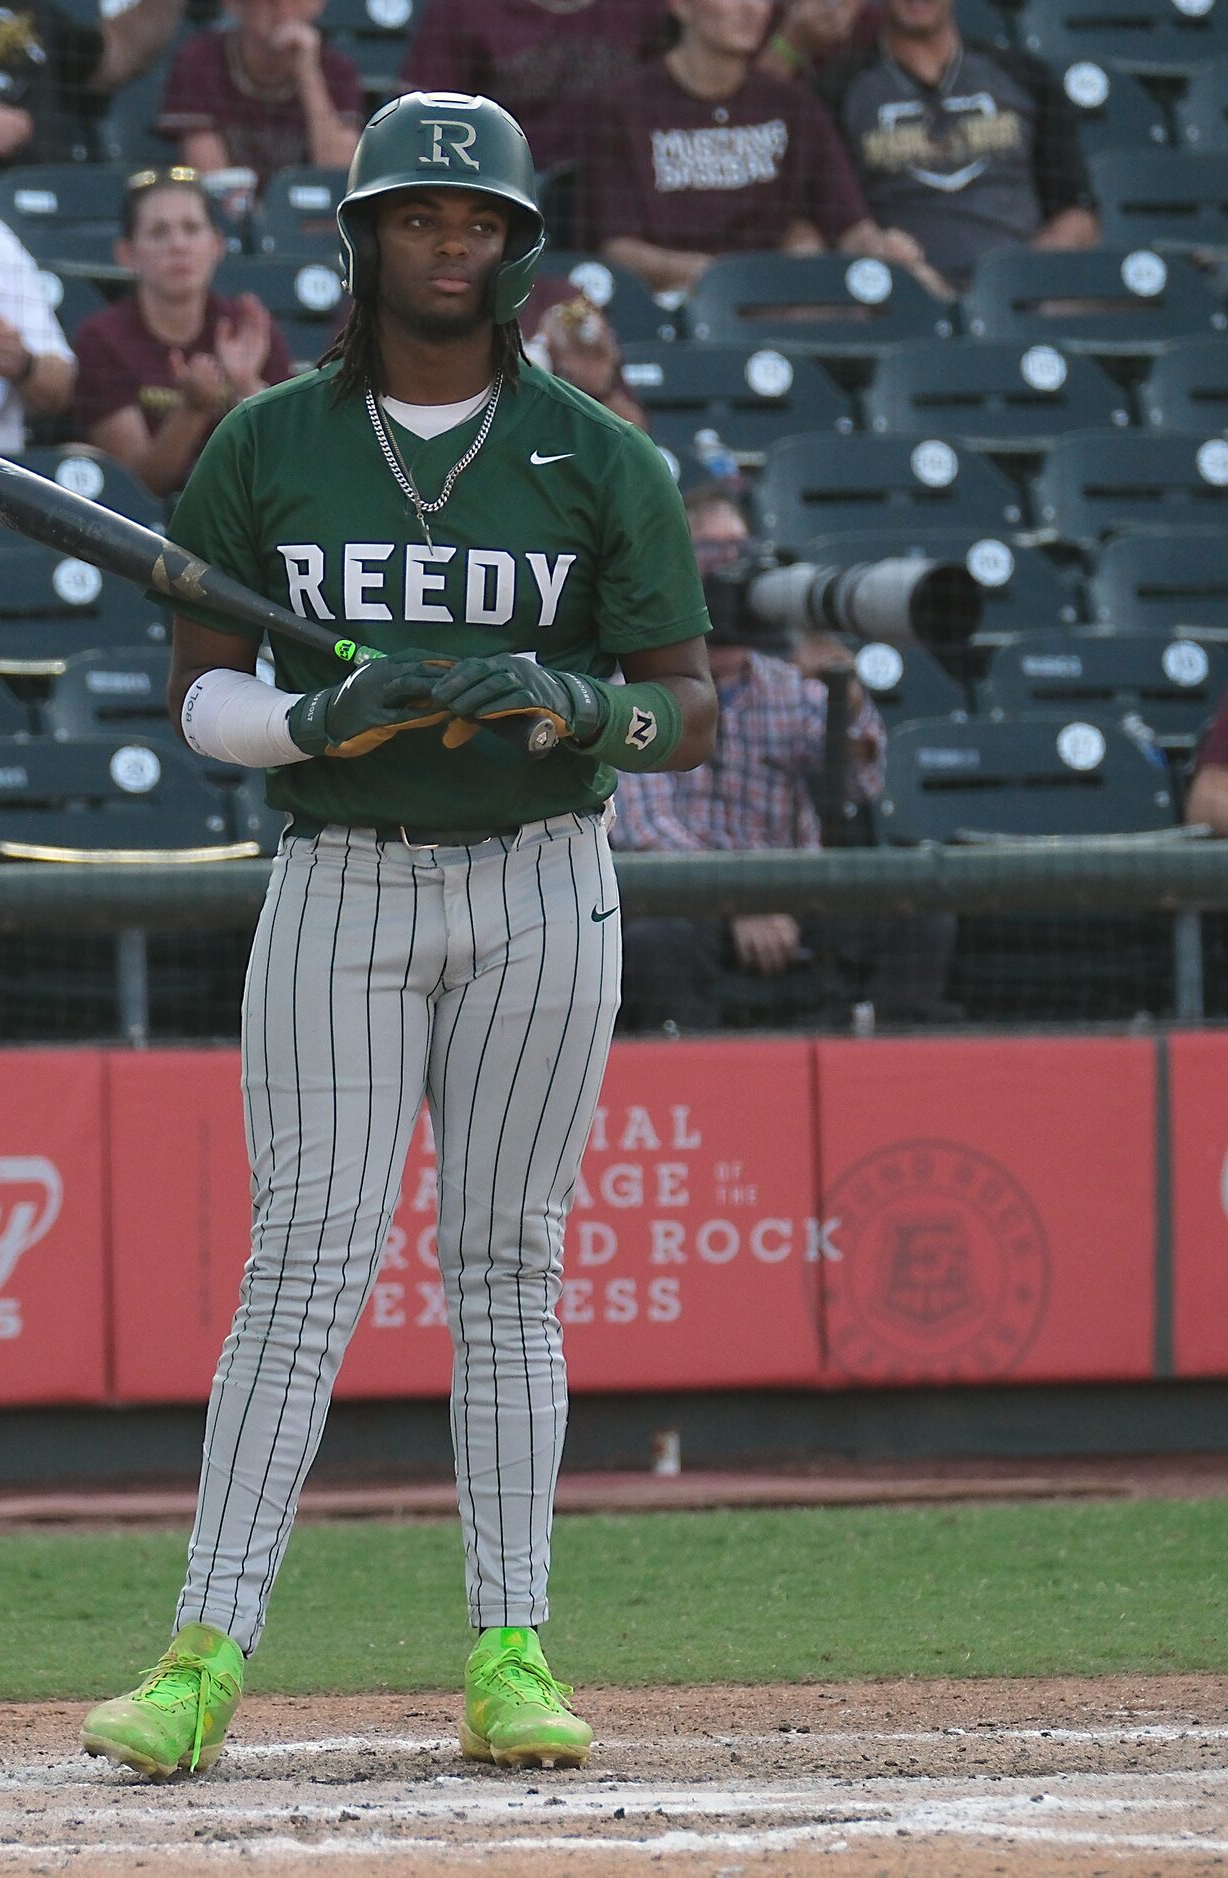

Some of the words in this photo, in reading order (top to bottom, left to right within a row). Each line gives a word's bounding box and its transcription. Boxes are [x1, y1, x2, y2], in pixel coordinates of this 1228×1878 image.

[417, 118, 481, 172] R
[276, 542, 578, 628] REEDY
[631, 712, 654, 745] N
[650, 1217, 845, 1266] ROCK
[374, 1276, 683, 1328] EXESS
